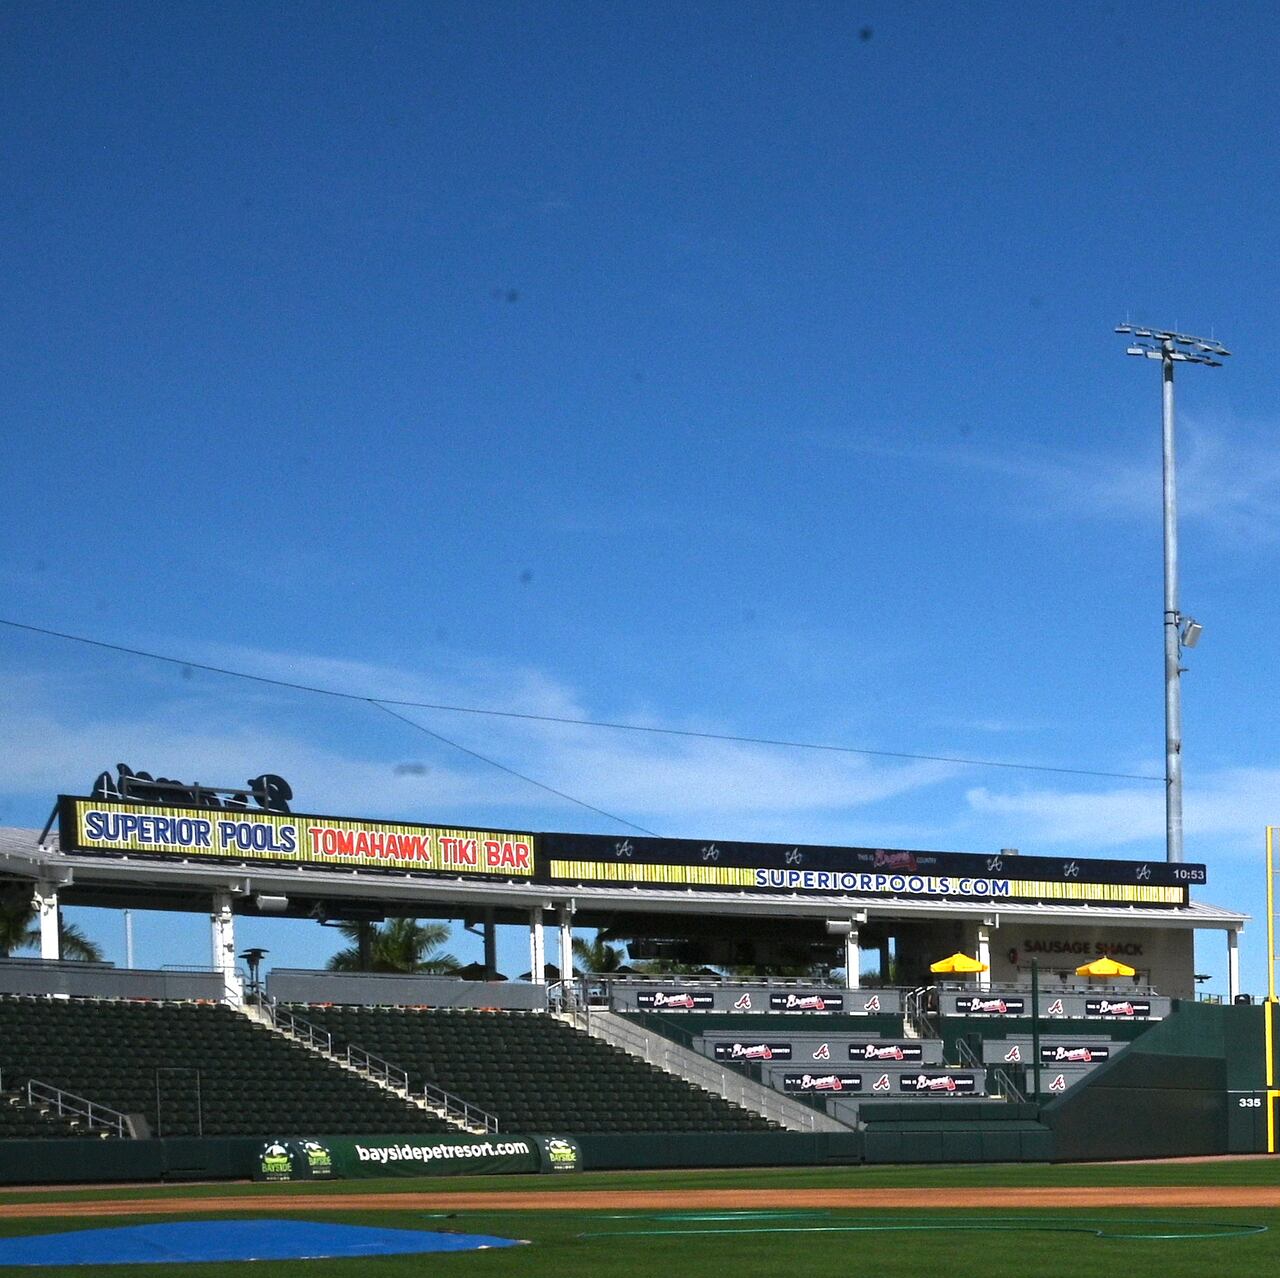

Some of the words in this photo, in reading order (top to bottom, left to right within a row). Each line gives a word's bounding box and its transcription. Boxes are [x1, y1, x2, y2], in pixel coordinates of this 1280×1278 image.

[84, 810, 211, 847] SUPERIOR
[217, 820, 297, 853] POOLS
[308, 827, 431, 862] TOMAHAWK
[483, 840, 530, 869] BAR
[1173, 869, 1205, 880] 10:53
[755, 868, 1010, 896] SUPERIORPOOLS.COM
[1023, 940, 1091, 955] SAUSAGE
[1239, 1098, 1261, 1107] 335
[355, 1141, 529, 1163] baysidepetresort.com
[549, 1153, 577, 1162] BAYSIDE
[261, 1162, 292, 1173] BAYSIDE
[308, 1156, 331, 1166] BAYSIDE
